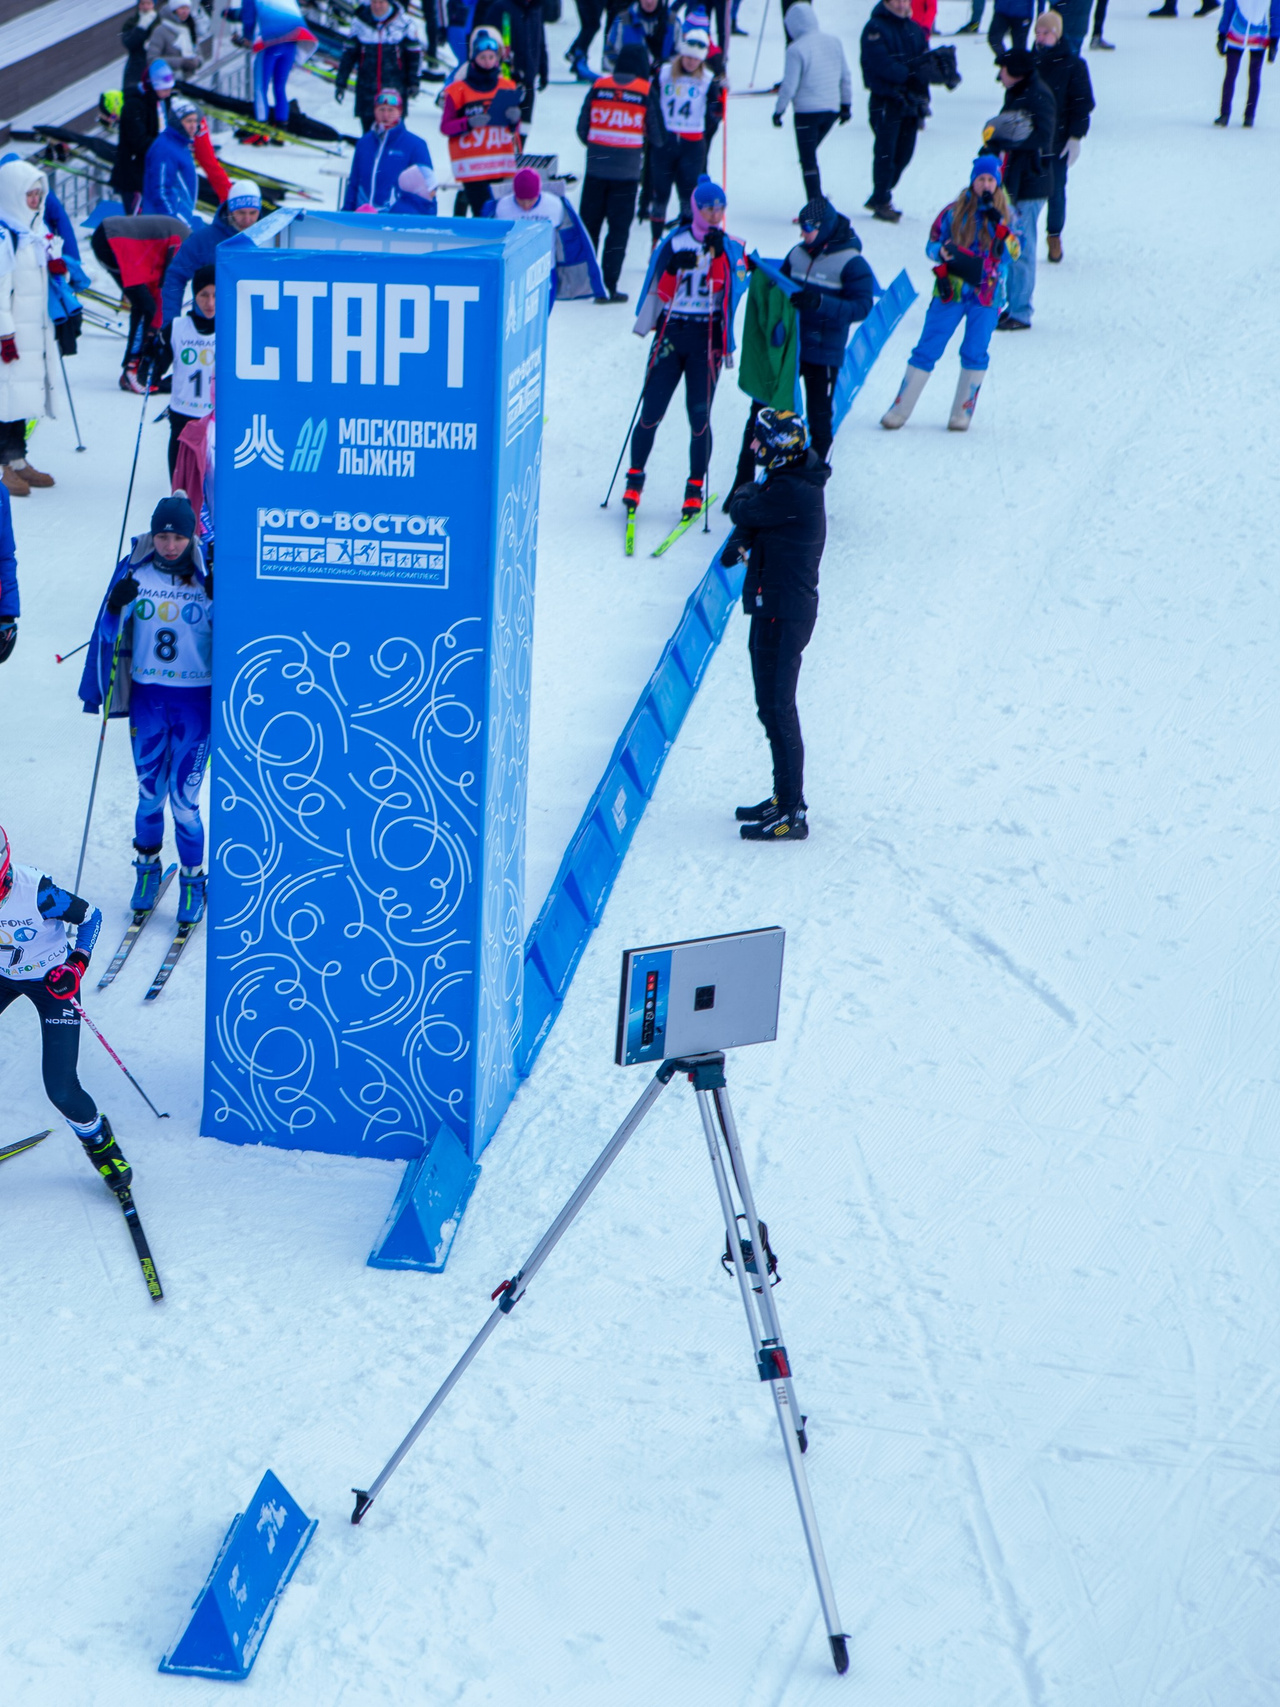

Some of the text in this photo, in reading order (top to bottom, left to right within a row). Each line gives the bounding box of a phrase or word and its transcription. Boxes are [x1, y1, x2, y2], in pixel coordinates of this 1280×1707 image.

[590, 107, 643, 128] СУДЬЯ
[666, 96, 693, 119] 14
[458, 126, 513, 149] СУДЬ
[235, 279, 480, 389] СТАРТ
[338, 417, 478, 451] МОСКОВСКАЯ
[337, 447, 416, 478] ЛЫЖНЯ
[256, 507, 451, 537] ЮГО-ВОСТОК
[154, 627, 179, 664] 8
[140, 1257, 162, 1297] FISCHER
